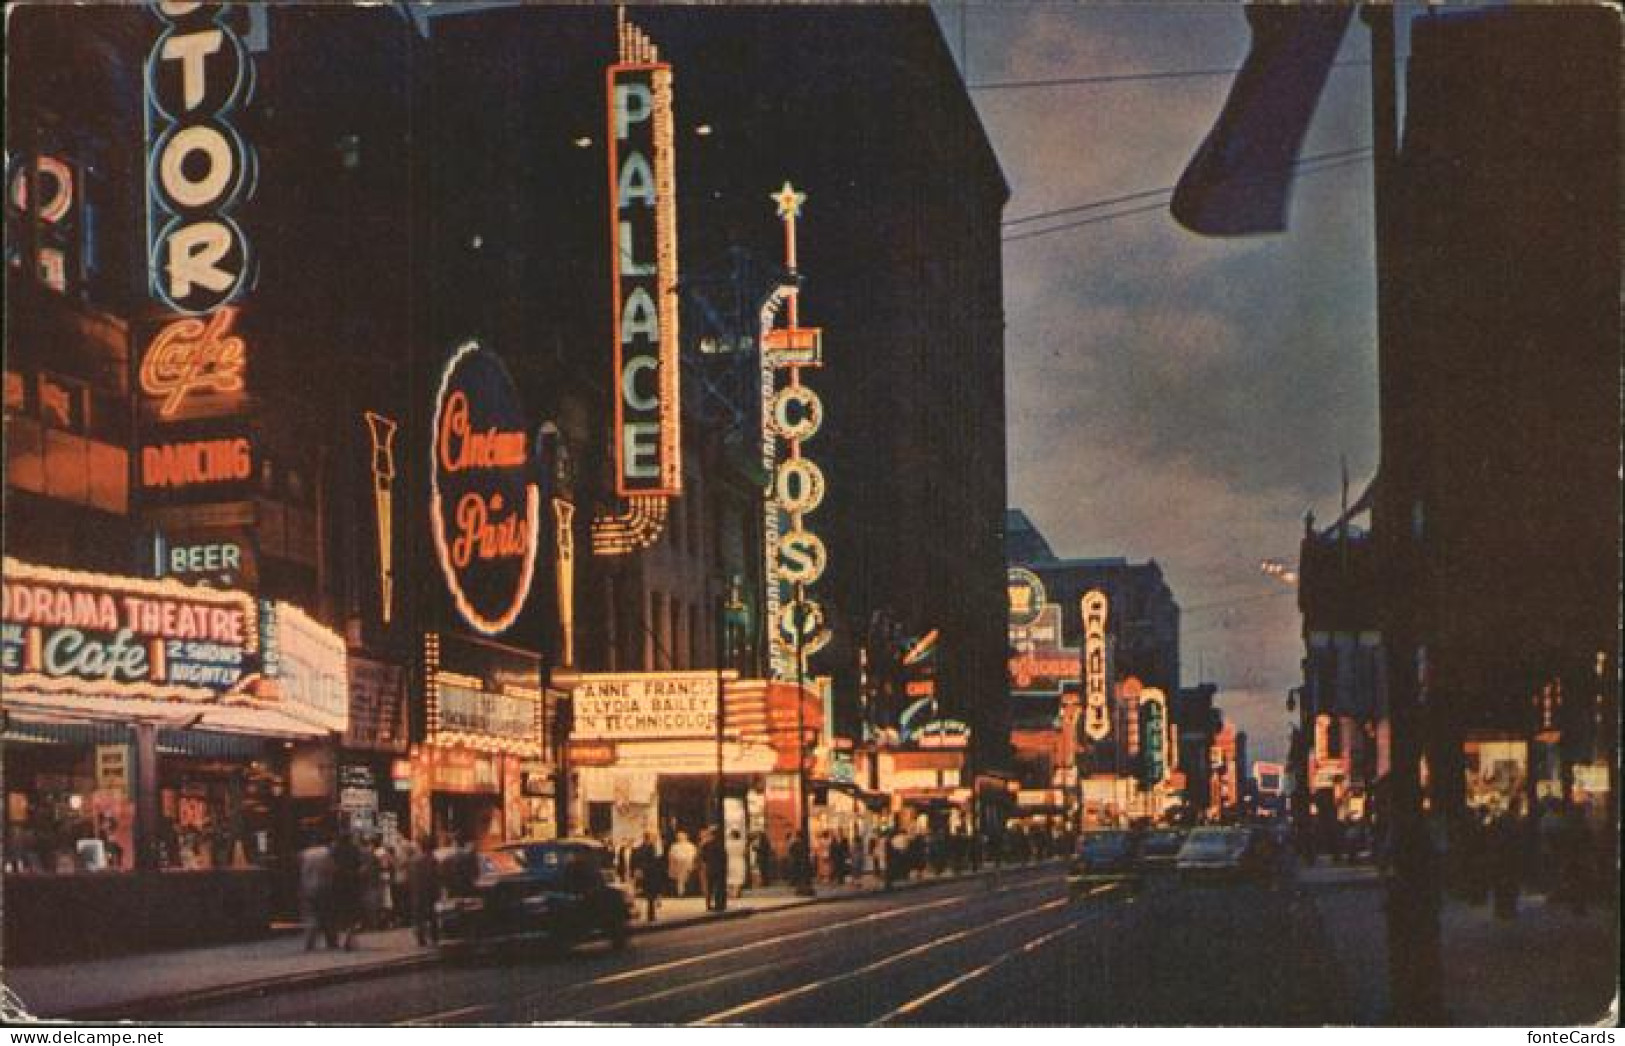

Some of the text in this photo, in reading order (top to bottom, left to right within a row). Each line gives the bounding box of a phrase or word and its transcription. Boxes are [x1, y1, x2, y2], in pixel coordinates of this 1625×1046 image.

[160, 1, 236, 297] TOR
[616, 84, 660, 478] PALACE
[143, 437, 251, 486] DANCING
[171, 543, 241, 573] BEER
[125, 597, 246, 642] THEATRE
[44, 628, 150, 681] Cafe
[584, 682, 631, 698] ANNE
[593, 699, 640, 714] LYDIA
[651, 698, 709, 713] BAILEY
